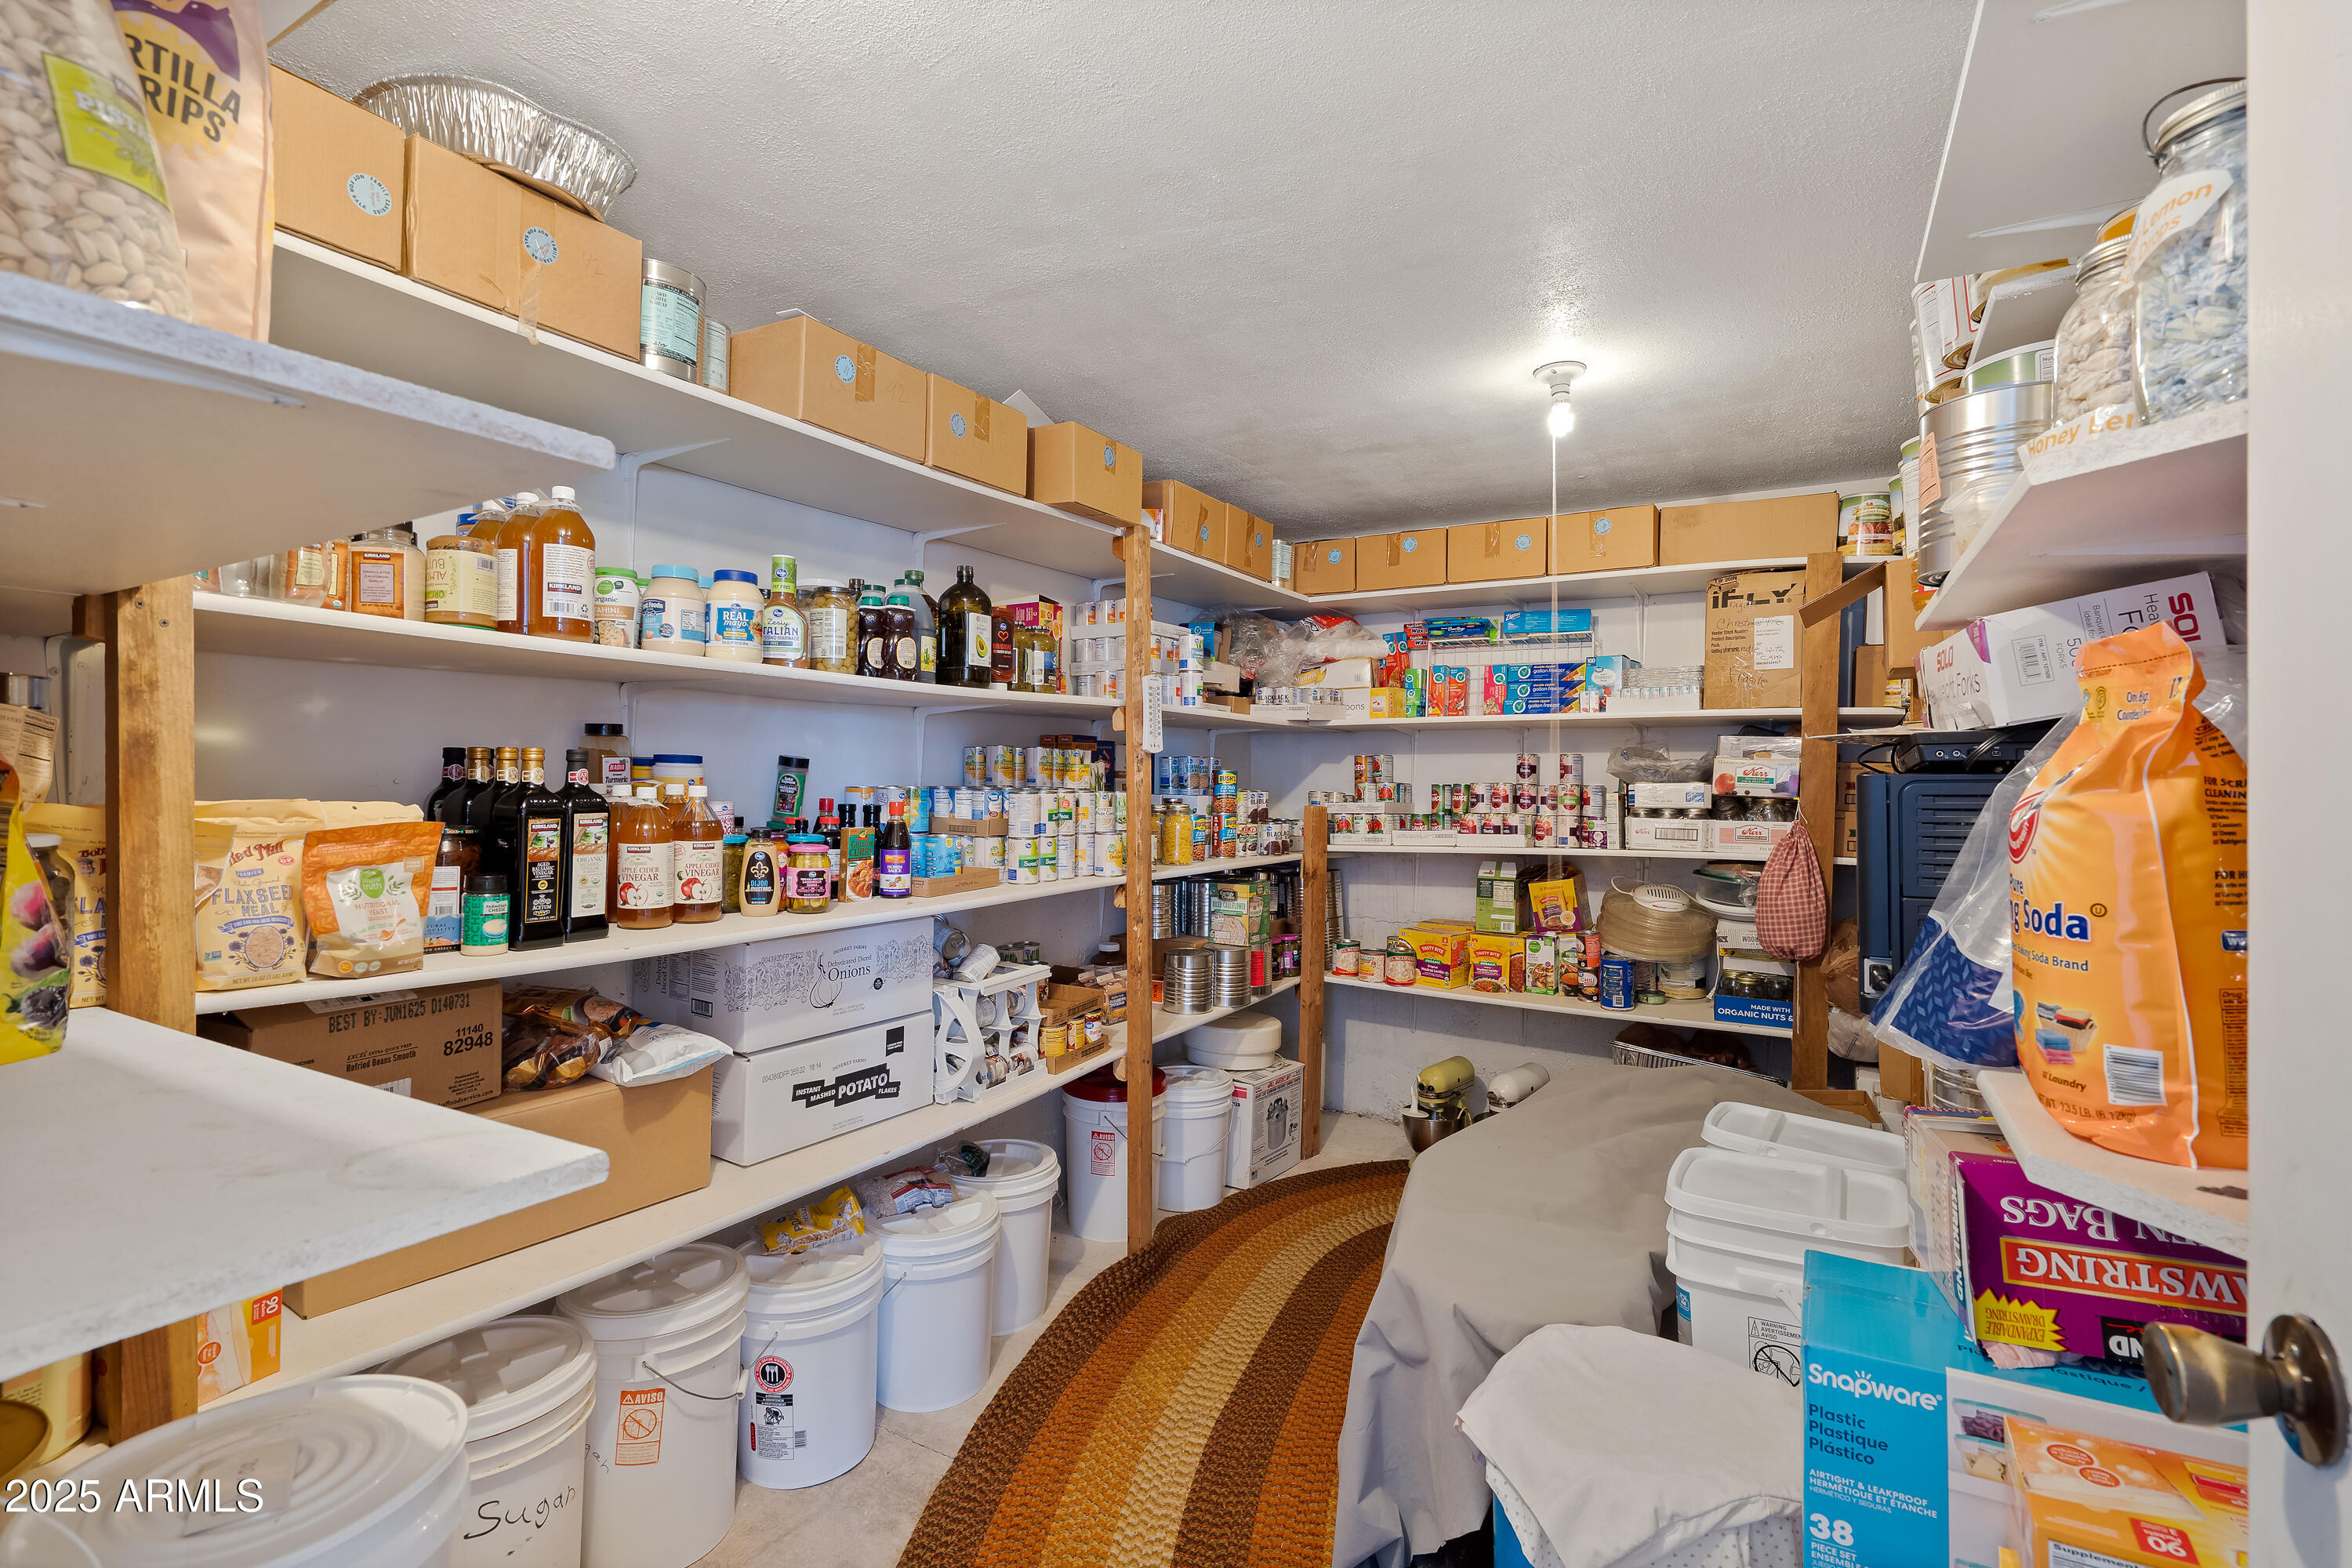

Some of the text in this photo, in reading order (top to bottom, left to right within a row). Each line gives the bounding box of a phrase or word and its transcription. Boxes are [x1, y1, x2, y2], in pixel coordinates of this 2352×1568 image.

[125, 32, 241, 125] RTILLA
[145, 78, 226, 143] RIPS
[2140, 182, 2214, 235] Lemon
[2138, 214, 2182, 263] Drops
[2027, 422, 2081, 456] Honey
[549, 583, 582, 591] KIRKLAND
[723, 611, 749, 622] REAL
[1505, 612, 1521, 621] Ziploc
[2092, 605, 2105, 634] Banquet
[763, 627, 798, 636] TALIAN
[1936, 645, 1954, 673] SOLO
[2056, 643, 2067, 670] FORKS
[1956, 673, 1980, 696] Forks
[1743, 767, 1769, 777] Kerr
[2204, 776, 2217, 786] FOR
[2205, 789, 2247, 798] CLEANIN
[849, 847, 873, 857] CURRY
[851, 840, 873, 848] GOLDEN
[2215, 871, 2235, 880] FOR
[212, 884, 292, 905] FLAXSEED
[362, 882, 383, 891] truth
[241, 902, 280, 916] MEAL
[354, 902, 401, 910] NUTRITIONAL
[2024, 898, 2089, 940] Soda
[827, 957, 857, 967] Dehydrated
[2032, 950, 2089, 971] Soda Brand
[828, 964, 870, 981] Onions
[1717, 1007, 1759, 1019] ORGANIC
[1761, 1011, 1785, 1021] NUTS
[1751, 1004, 1772, 1012] MADE
[328, 1013, 357, 1033] BEST
[456, 1024, 484, 1037] 11140
[444, 1032, 493, 1056] 82948
[347, 1050, 416, 1072] Refried Beans Smooth
[833, 1061, 852, 1071] DESERET
[796, 1086, 822, 1096] INSTANT
[811, 1090, 836, 1102] MASHED
[838, 1073, 887, 1098] POTATO
[2048, 1073, 2087, 1092] Laundry
[1098, 1133, 1116, 1142] AVISO
[1999, 1195, 2118, 1242] BAGS
[1951, 1186, 1963, 1301] KIRKLAND
[266, 1295, 279, 1314] 90
[1761, 1320, 1787, 1331] WARNING
[1986, 1307, 2045, 1327] DRAWSTRING
[1761, 1327, 1801, 1339] AVERTISSEMEN
[1761, 1332, 1777, 1341] AVISO
[1985, 1321, 2046, 1343] EXPANDABLE
[635, 1391, 663, 1404] AVISO
[1808, 1403, 1866, 1430] Plastic
[1808, 1421, 1889, 1453] Plastique
[1808, 1436, 1875, 1466] Plástico
[1809, 1468, 1855, 1487] AIRTIGHT
[1867, 1484, 1928, 1507] LEAKPROOF
[1809, 1476, 1873, 1501] HERMÉTIQUE
[1890, 1497, 1937, 1519] ÉTANCHE
[1858, 1499, 1892, 1514] SEGURAS
[1809, 1512, 1854, 1546] 38
[1811, 1541, 1857, 1562] PIECE SET
[2147, 1536, 2187, 1558] 90
